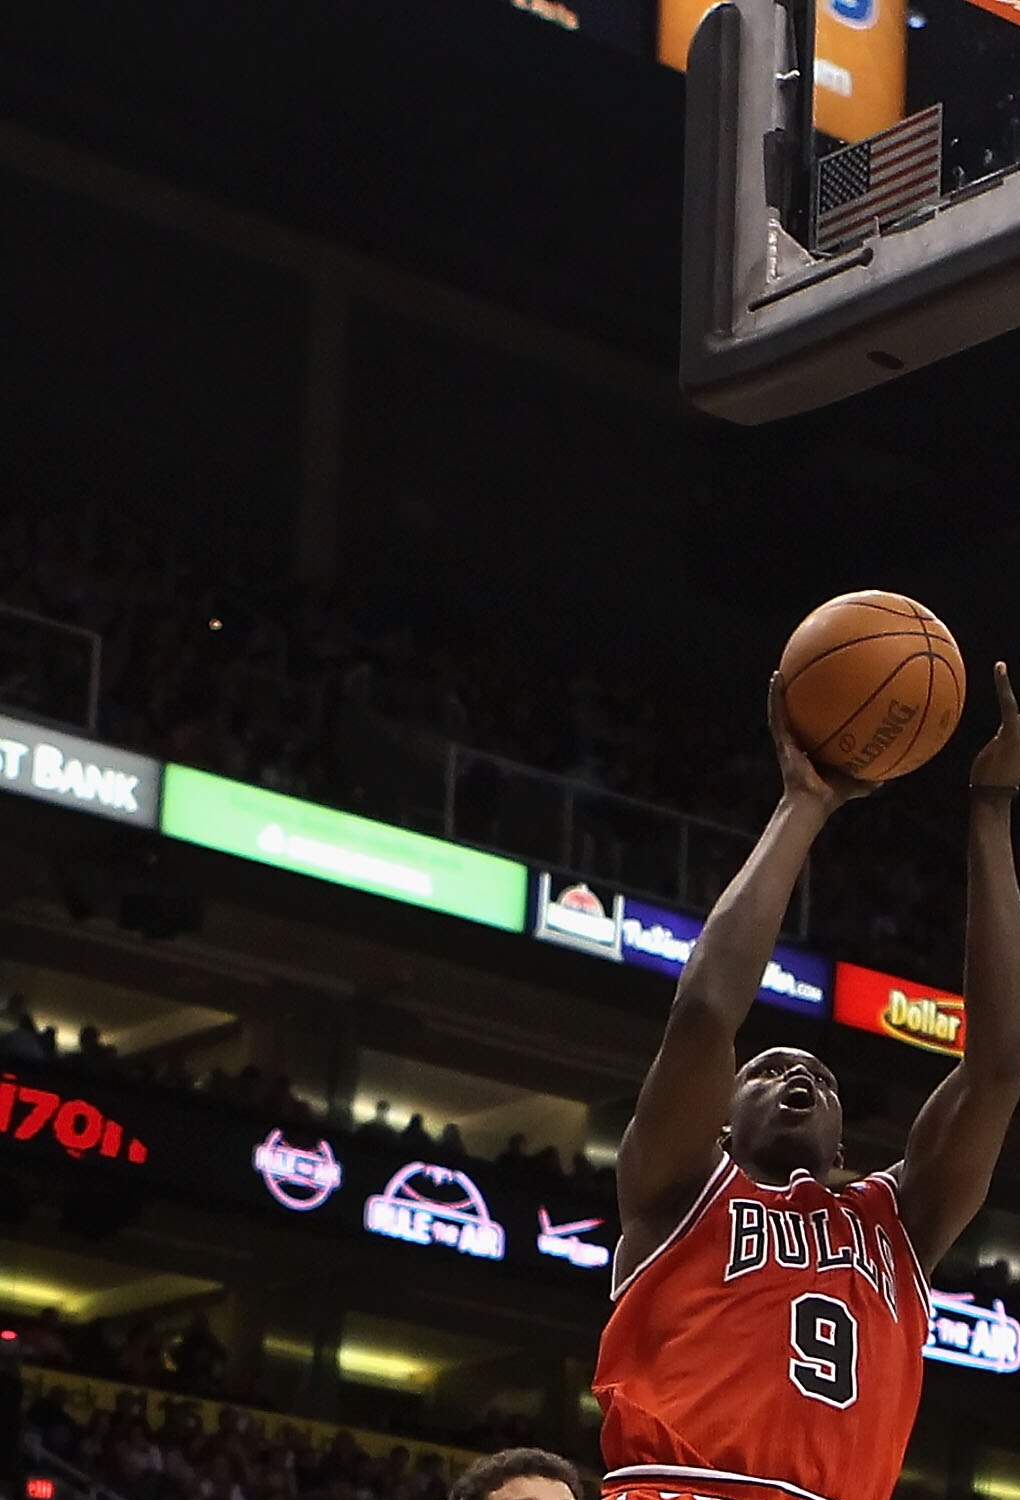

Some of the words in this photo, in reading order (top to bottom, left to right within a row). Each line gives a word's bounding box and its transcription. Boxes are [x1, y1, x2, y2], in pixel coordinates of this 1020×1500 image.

[0, 739, 29, 780] T
[888, 989, 961, 1042] Dollar
[724, 1199, 898, 1323] BULLS
[789, 1292, 858, 1409] 9
[969, 1319, 1018, 1363] AIR
